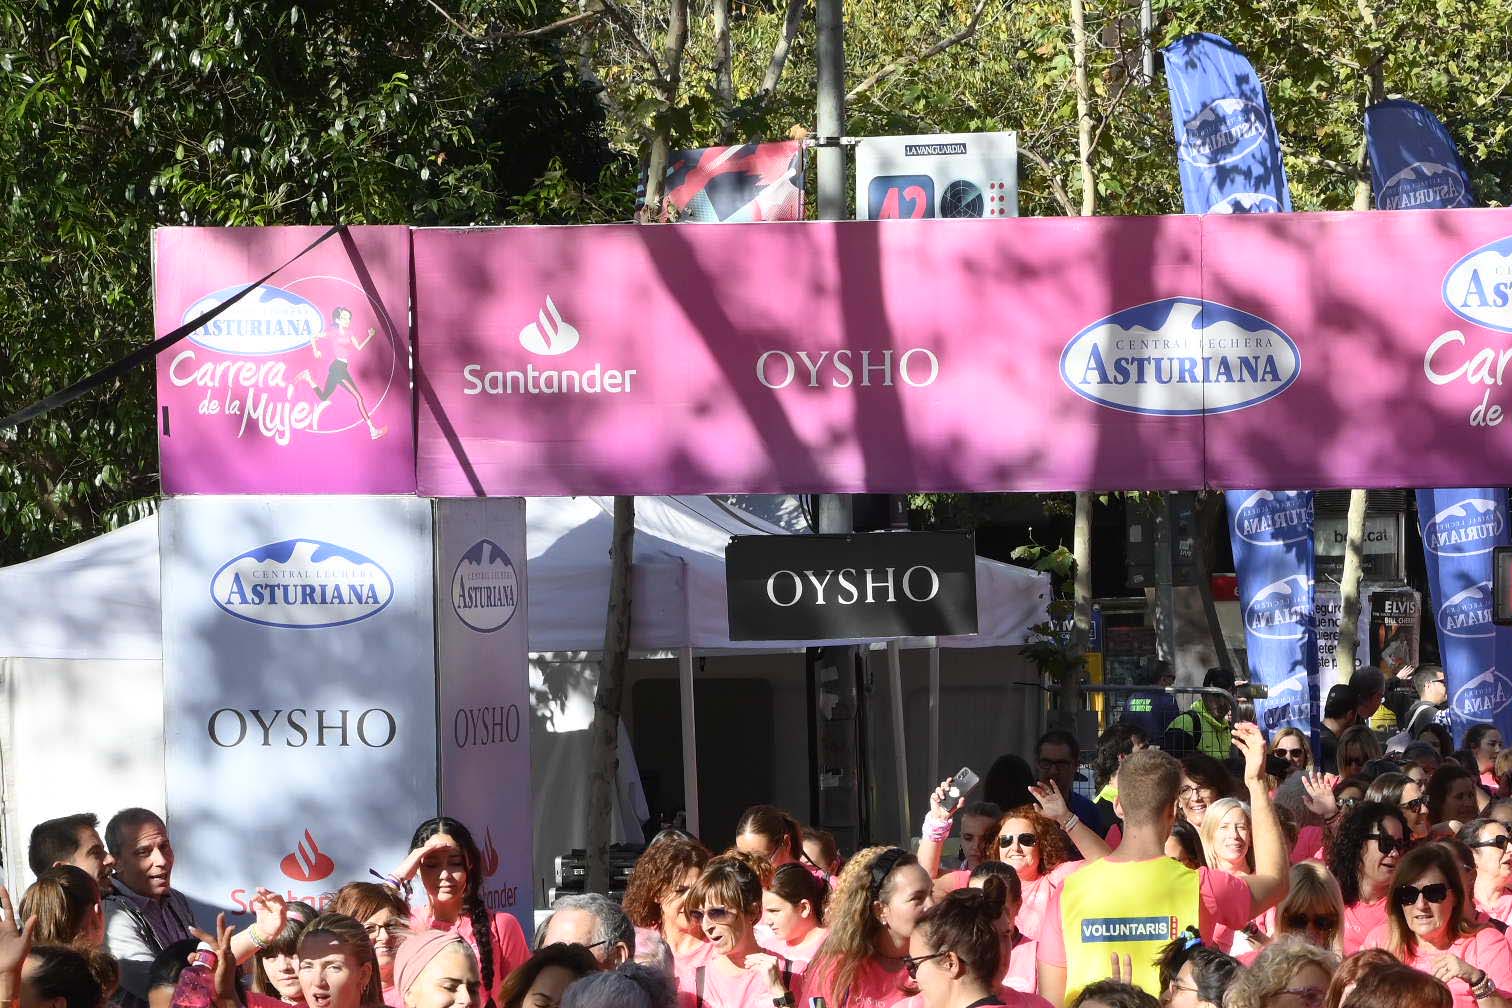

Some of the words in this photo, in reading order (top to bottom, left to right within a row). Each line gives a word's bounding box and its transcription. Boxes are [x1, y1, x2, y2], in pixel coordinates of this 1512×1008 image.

[169, 351, 288, 387] Carrera
[463, 363, 637, 396] Santander
[756, 347, 940, 389] OYSHO
[1079, 342, 1282, 385] ASTURIANA
[198, 390, 220, 415] de
[224, 383, 240, 415] la
[238, 386, 332, 446] Mujer
[1469, 388, 1504, 427] de
[225, 572, 381, 607] ASTURIANA
[456, 575, 516, 609] ASTURIANA
[766, 565, 940, 608] OYSHO
[1384, 601, 1416, 614] ELVIS
[207, 708, 398, 748] OYSHO
[454, 704, 521, 749] OYSHO
[1083, 923, 1168, 936] VOLUNTARIS
